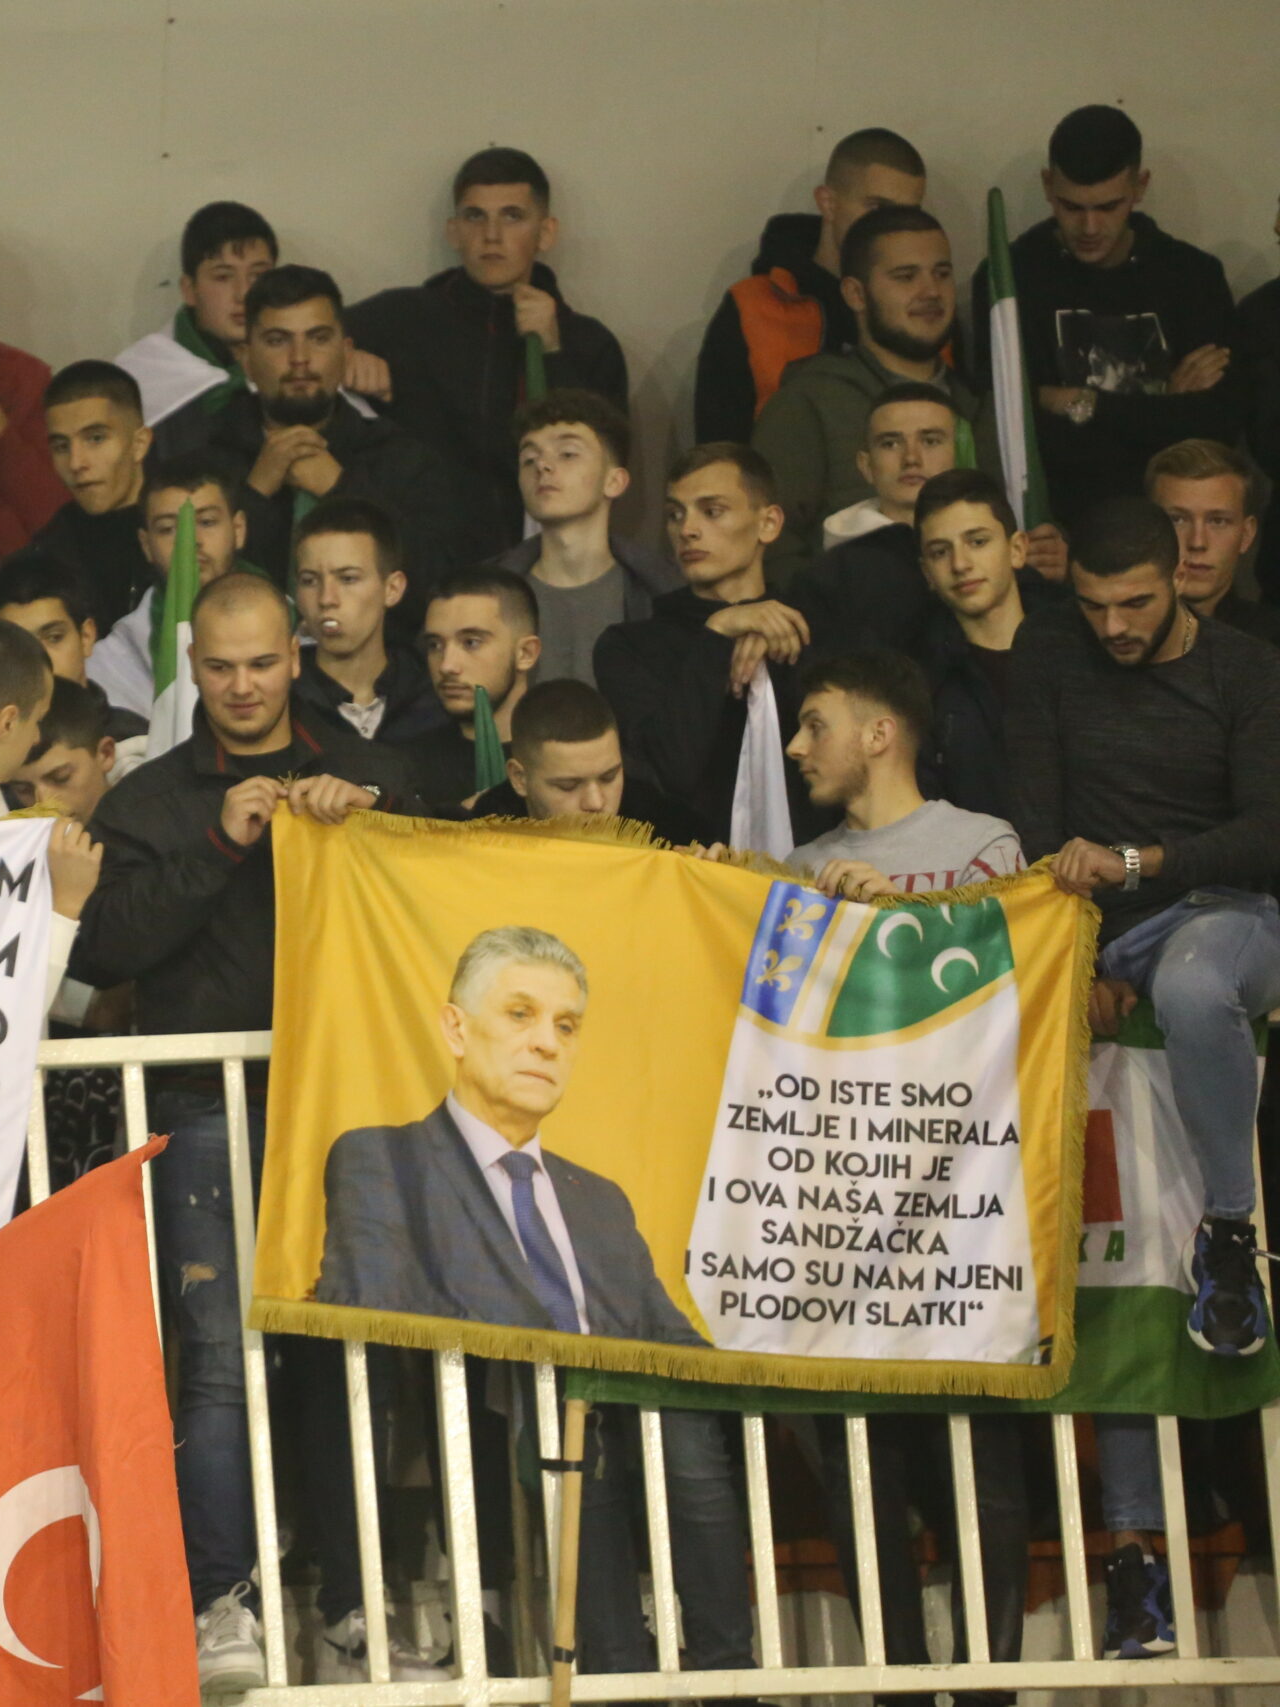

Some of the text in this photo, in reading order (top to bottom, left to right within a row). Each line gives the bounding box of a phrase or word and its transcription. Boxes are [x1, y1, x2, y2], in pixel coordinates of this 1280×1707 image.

[830, 1079, 892, 1107] ISTE
[901, 1081, 973, 1108] SMO
[727, 1103, 1020, 1147] ZEMLJE I MINERALA
[768, 1146, 954, 1182] OD KOJIH JE
[708, 1176, 1005, 1220] I OVA NAŠA ZEMLJA
[761, 1216, 950, 1256] SANDŽAČKA
[684, 1249, 1023, 1292] I SAMO SU NAM NJENI
[719, 1290, 855, 1326] PLODOVI
